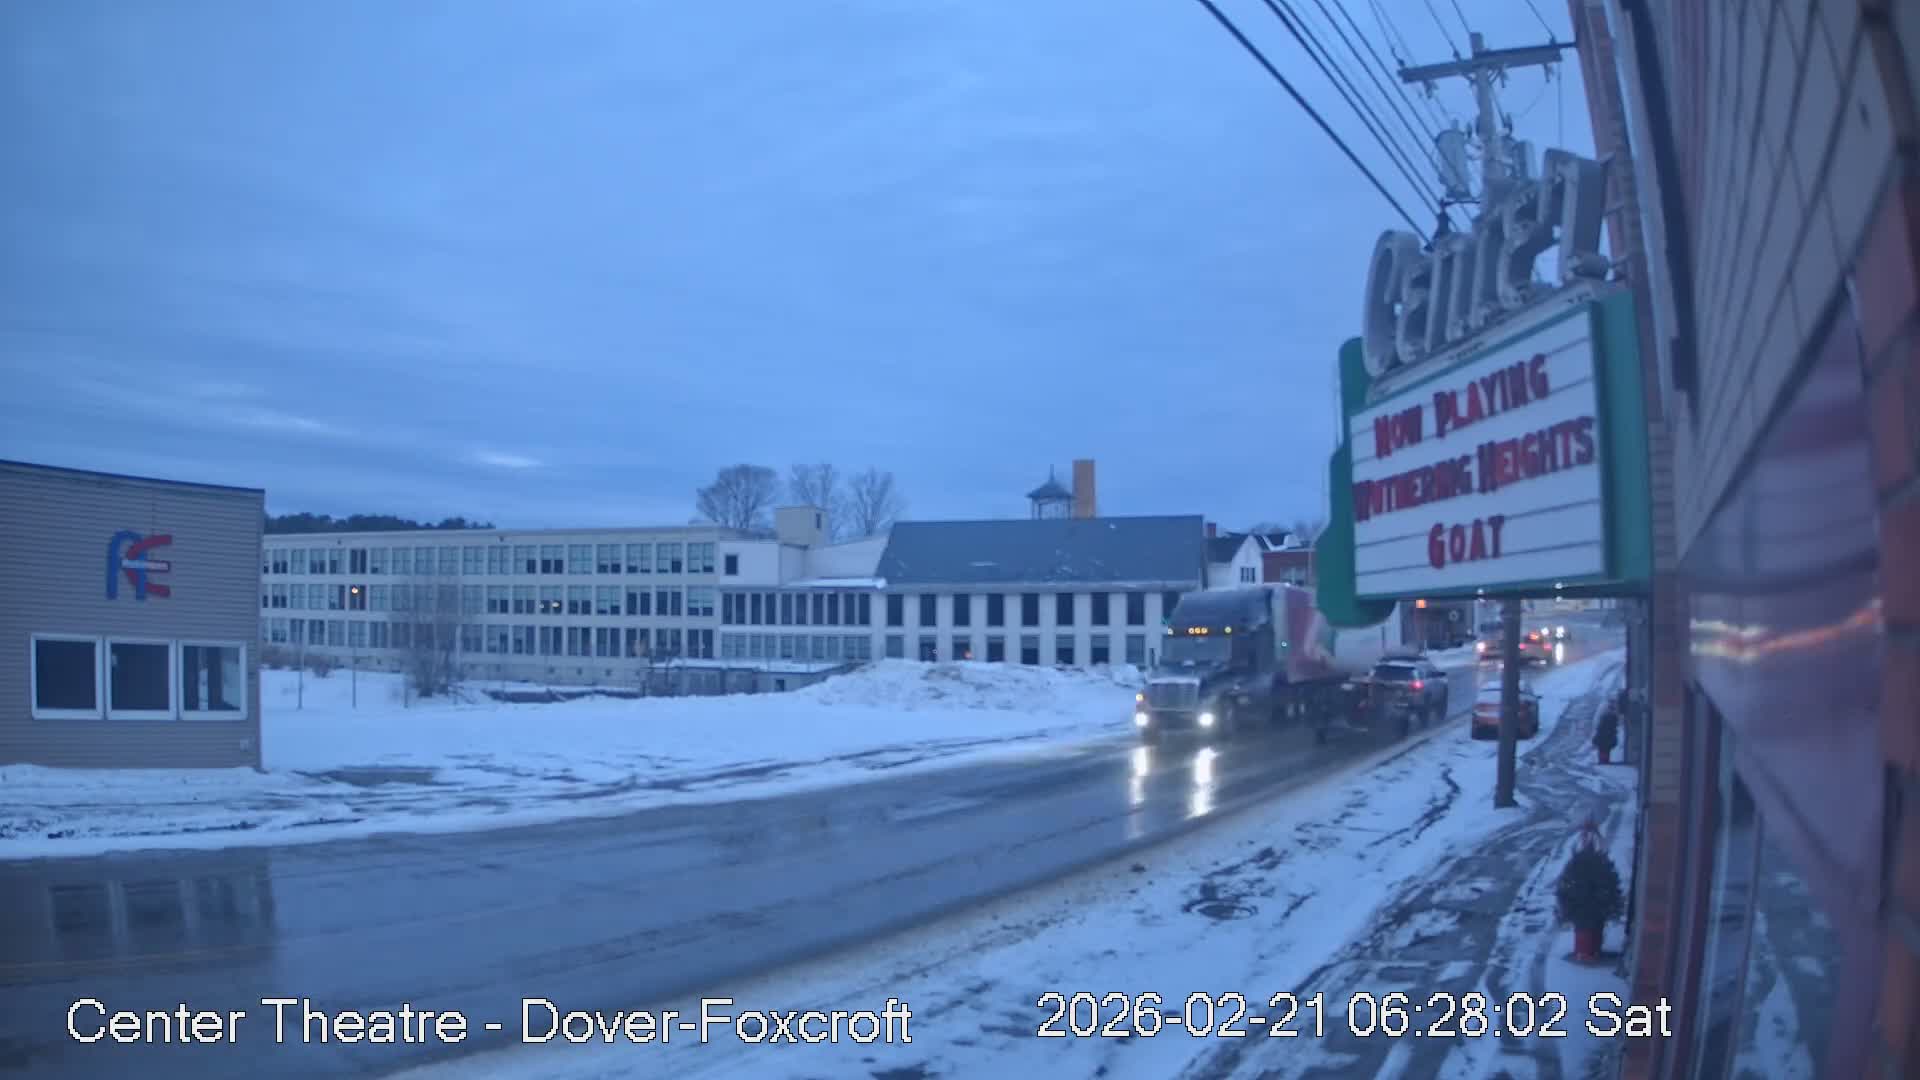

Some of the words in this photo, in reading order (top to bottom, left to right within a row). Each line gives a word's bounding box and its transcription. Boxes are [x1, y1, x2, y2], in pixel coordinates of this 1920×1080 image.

[1373, 404, 1423, 460] NOW
[1433, 353, 1550, 439] PLAYING
[1477, 416, 1595, 494] HEIGHTS
[1428, 514, 1505, 569] GOAT
